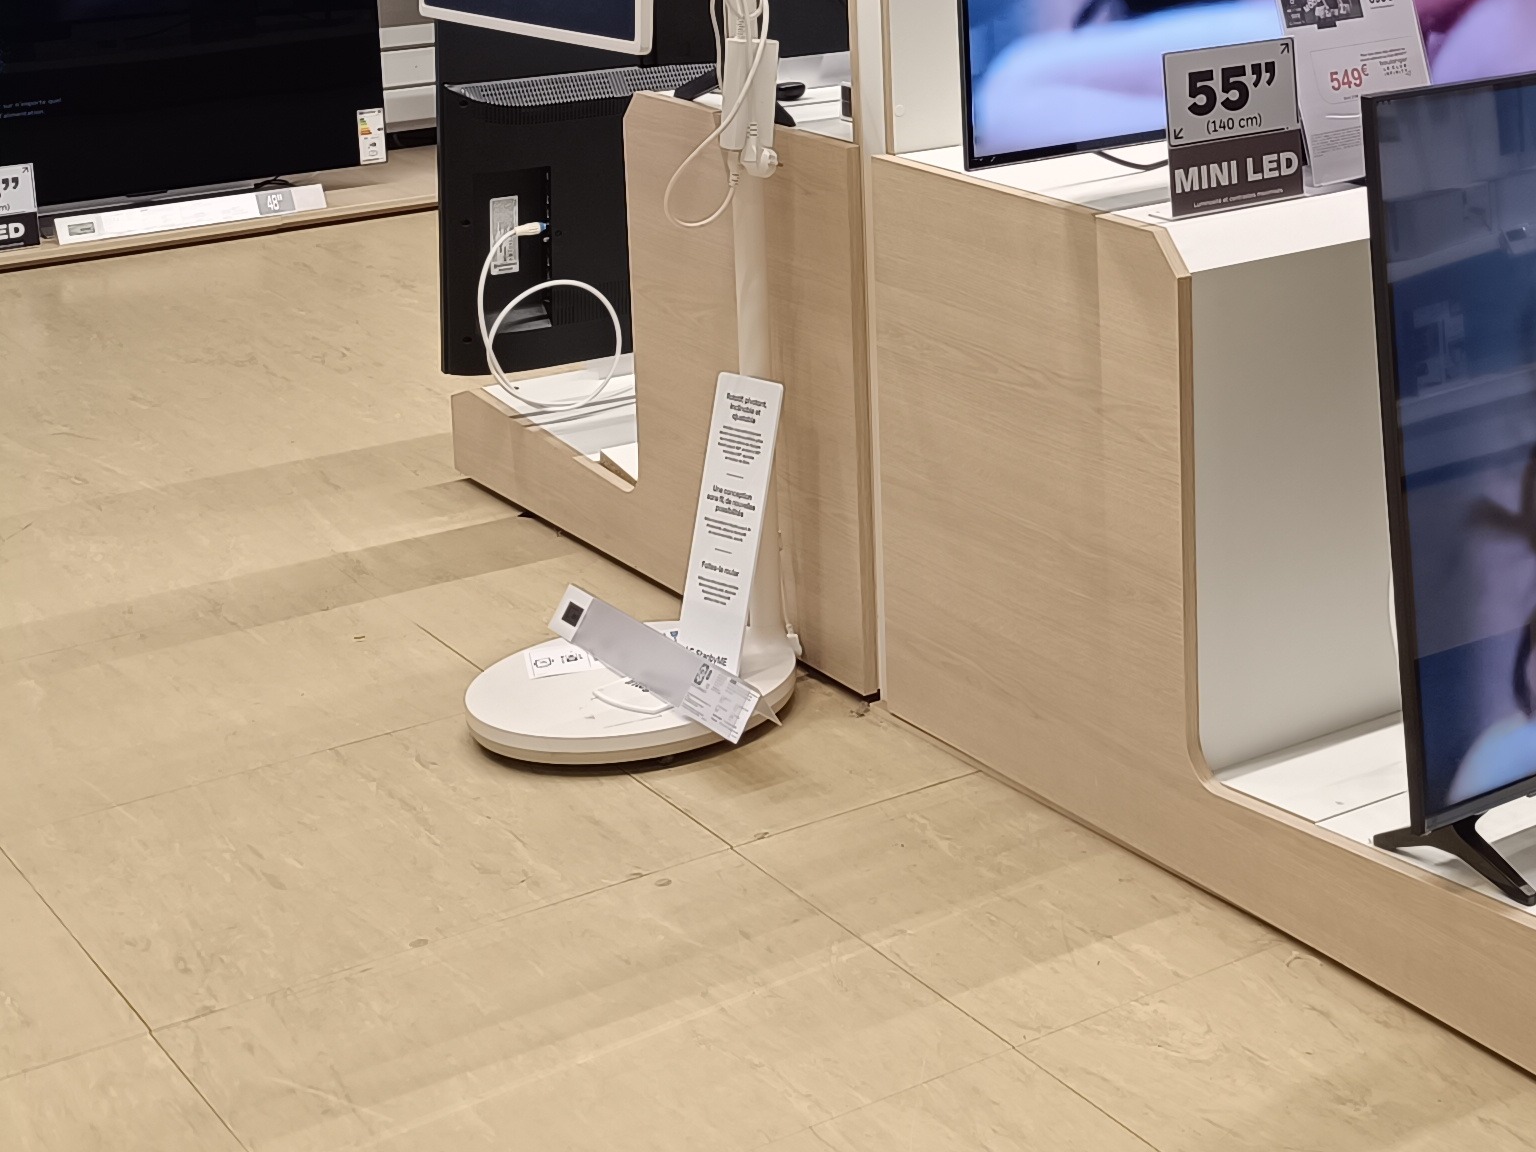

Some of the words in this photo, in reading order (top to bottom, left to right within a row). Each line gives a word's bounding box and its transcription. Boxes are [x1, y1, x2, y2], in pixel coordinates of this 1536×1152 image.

[1330, 63, 1369, 91] 549€
[1206, 117, 1234, 135] (140
[1239, 113, 1262, 128] cm)
[1174, 160, 1238, 193] MINI
[1246, 151, 1299, 182] LED
[713, 485, 723, 493] Une
[724, 489, 752, 500] conception
